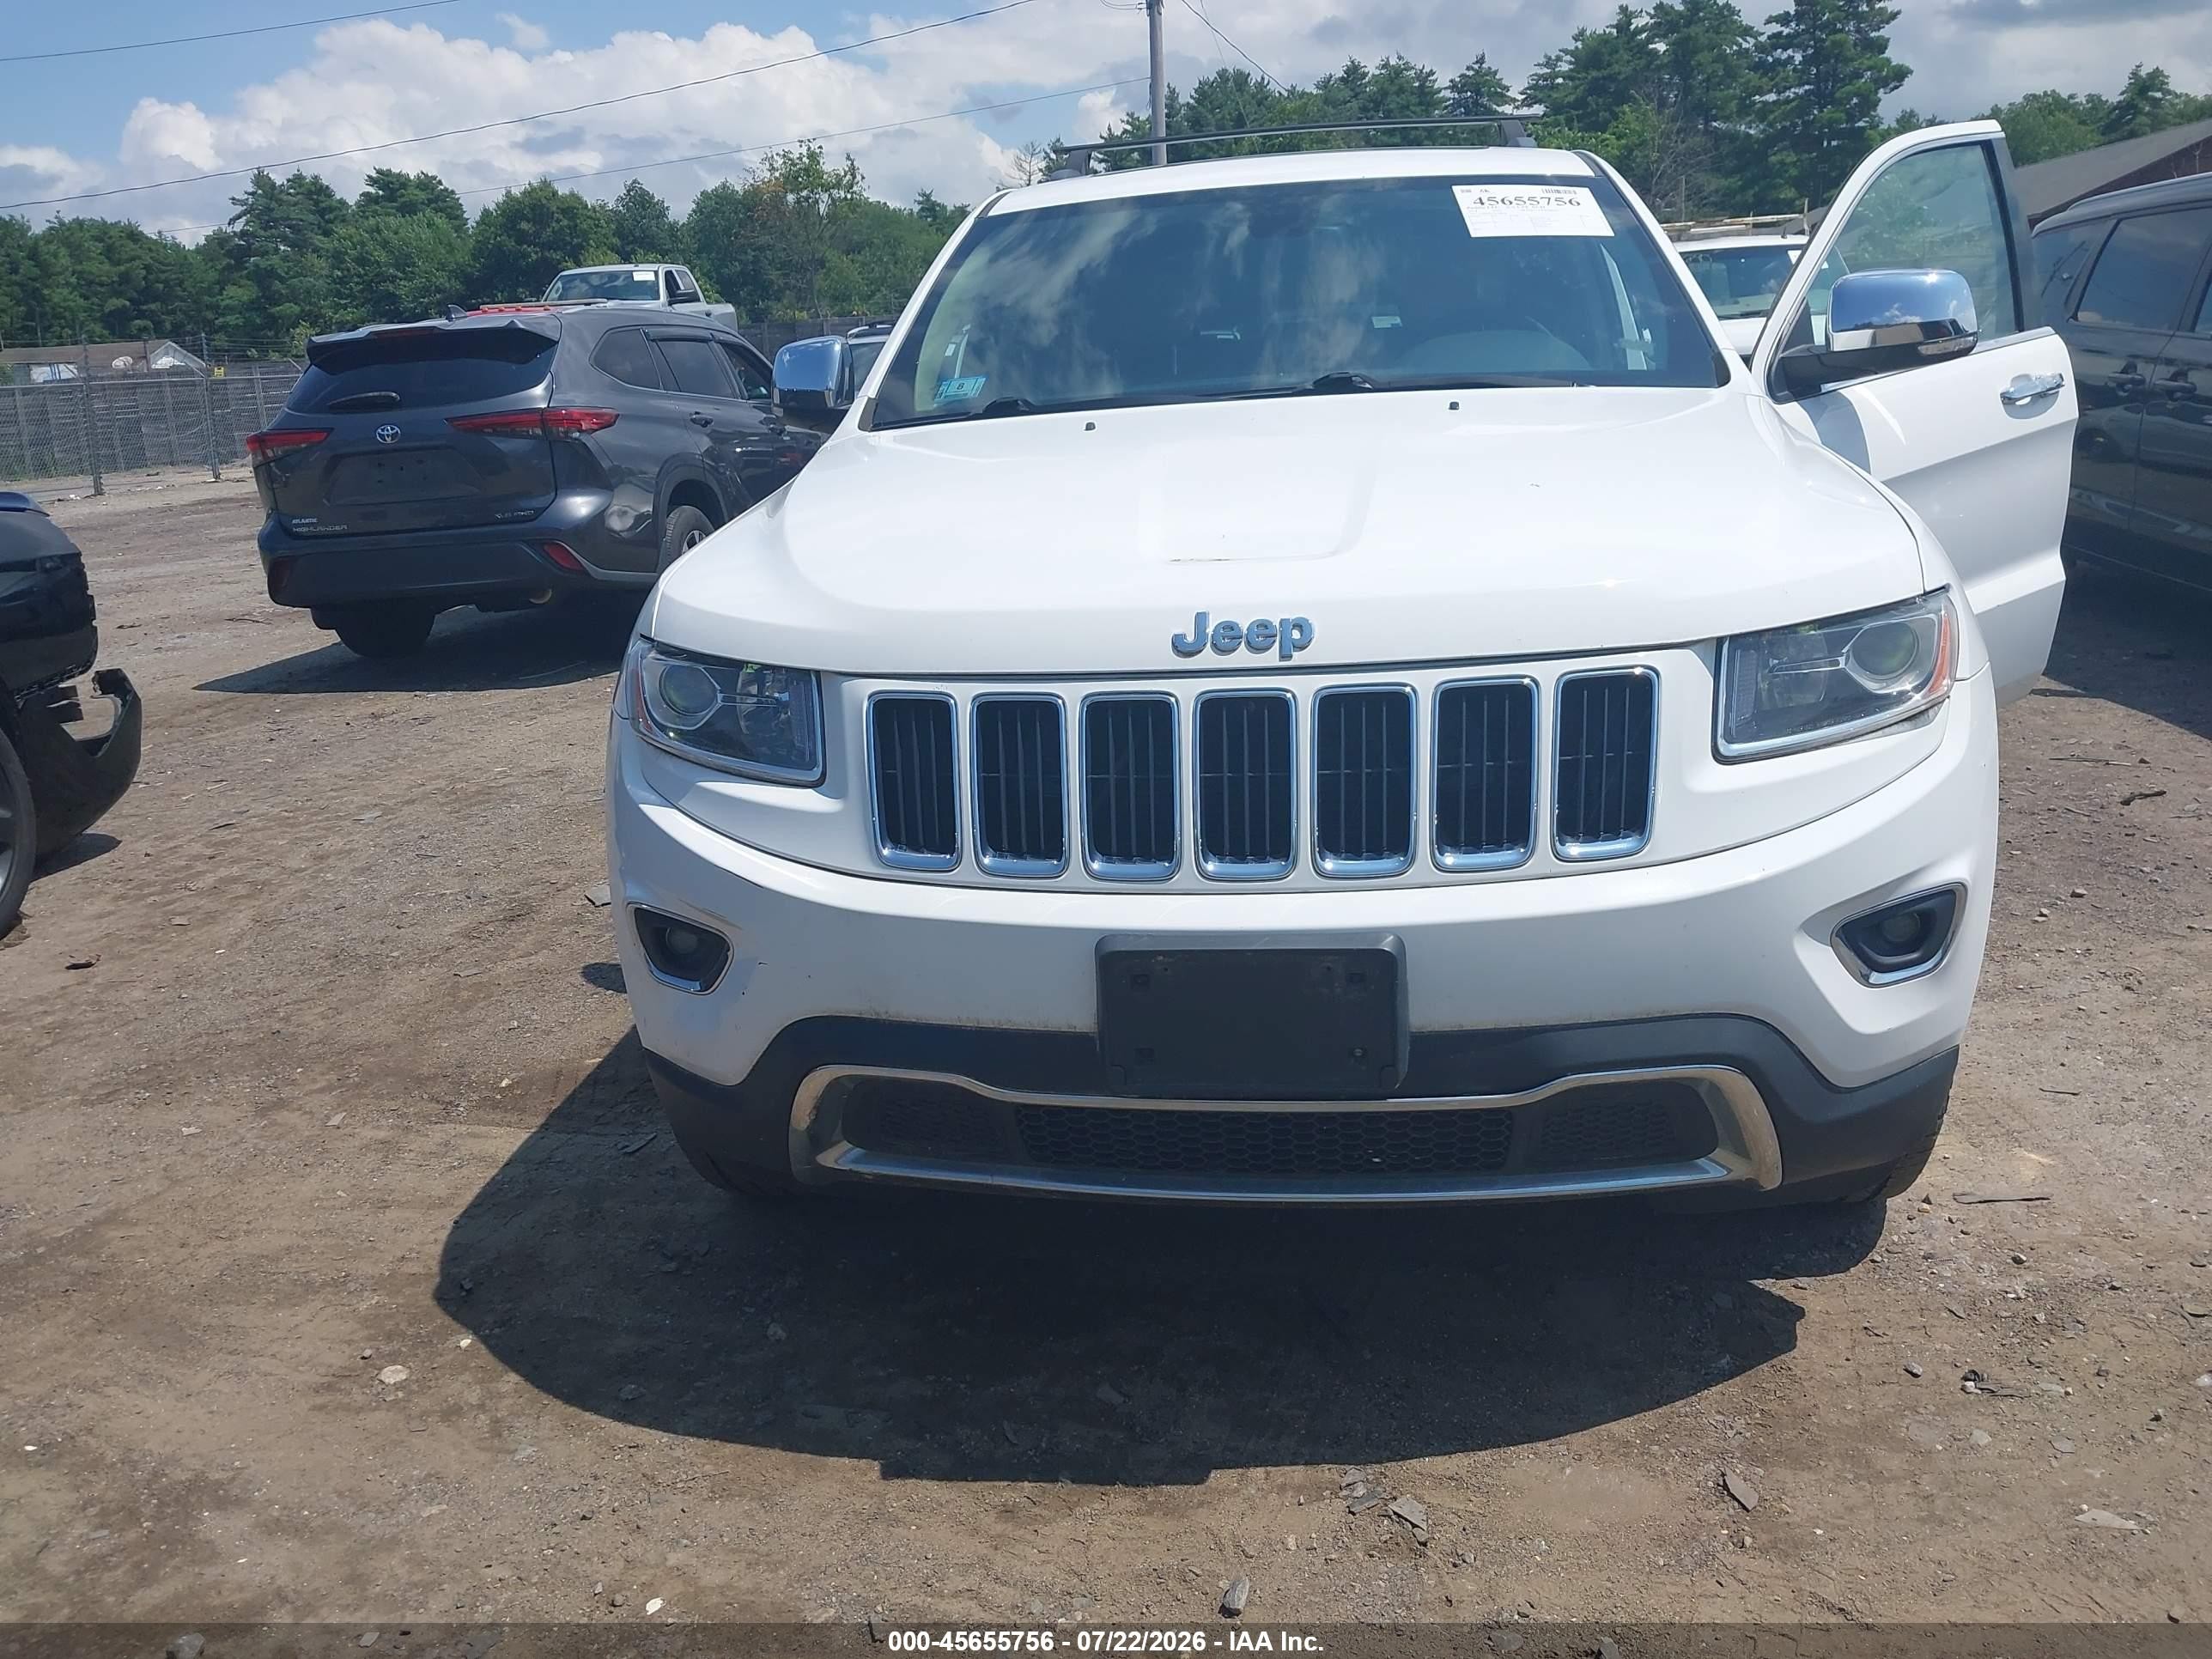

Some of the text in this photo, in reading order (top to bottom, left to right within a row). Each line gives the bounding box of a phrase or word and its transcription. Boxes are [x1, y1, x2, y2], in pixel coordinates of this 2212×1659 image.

[1473, 196, 1581, 207] 45655756
[956, 382, 965, 391] 8
[1171, 611, 1315, 661] Jeep
